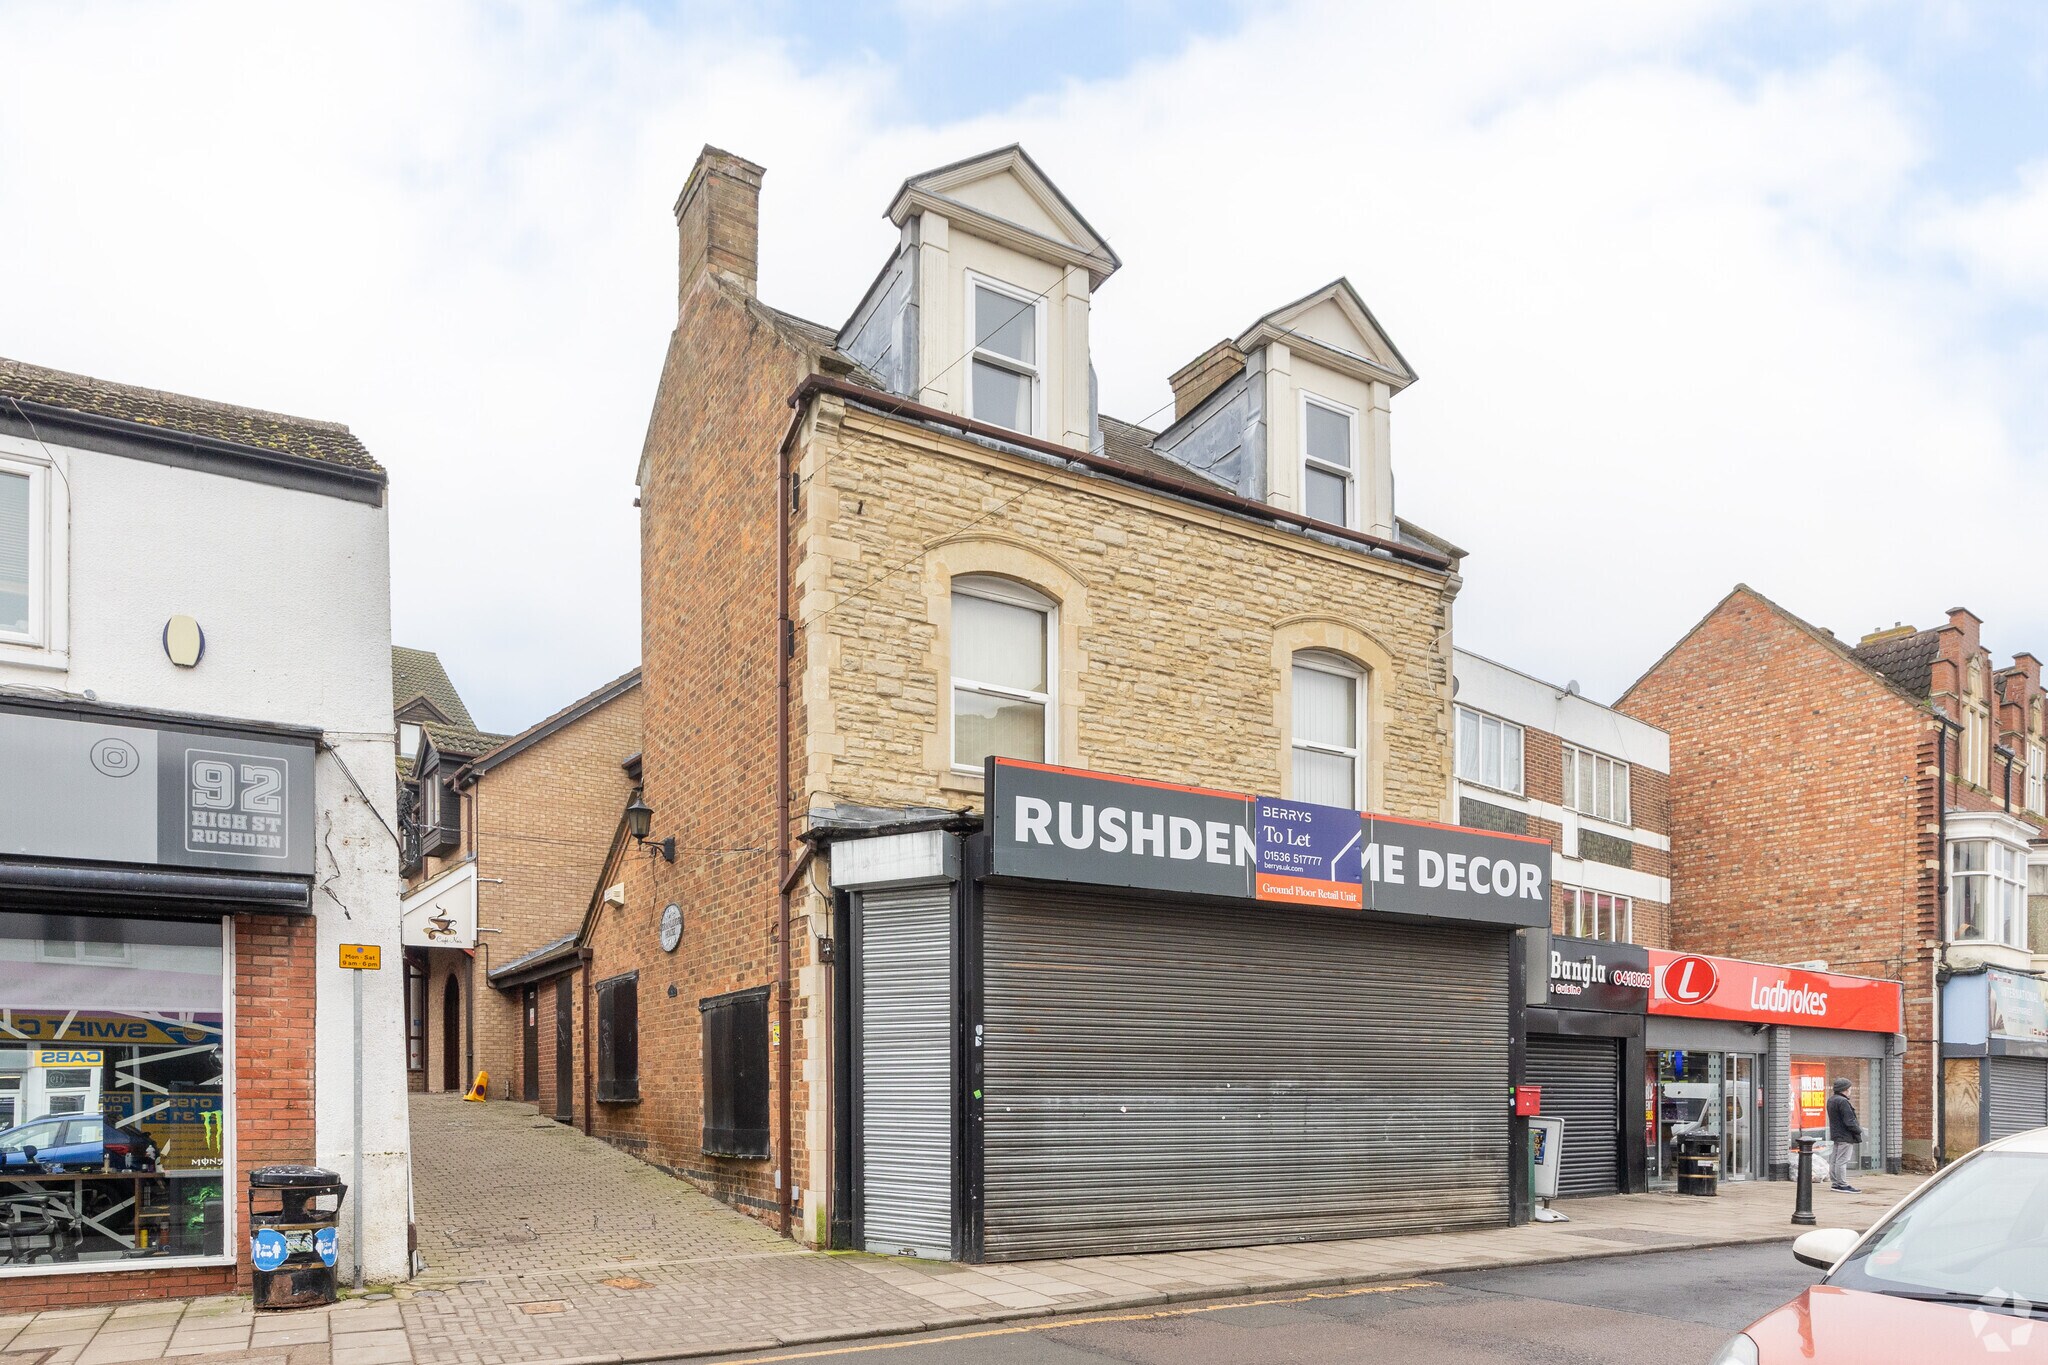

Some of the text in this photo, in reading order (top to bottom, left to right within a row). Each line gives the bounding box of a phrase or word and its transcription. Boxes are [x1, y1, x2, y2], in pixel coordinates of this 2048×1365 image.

[192, 760, 281, 814] 92
[192, 810, 281, 832] HIGH ST
[1263, 806, 1312, 822] BERRYS
[192, 829, 280, 848] RUSHDEN
[1263, 825, 1311, 847] To Let
[1264, 851, 1322, 866] 01536 517777
[1264, 862, 1303, 873] berrys.uk.com
[1418, 849, 1543, 900] DECOR
[1262, 883, 1356, 902] Ground Floor Retail Unit
[1622, 972, 1651, 988] 418025
[1751, 976, 1828, 1016] Ladbrokes
[1812, 1092, 1824, 1106] FREE
